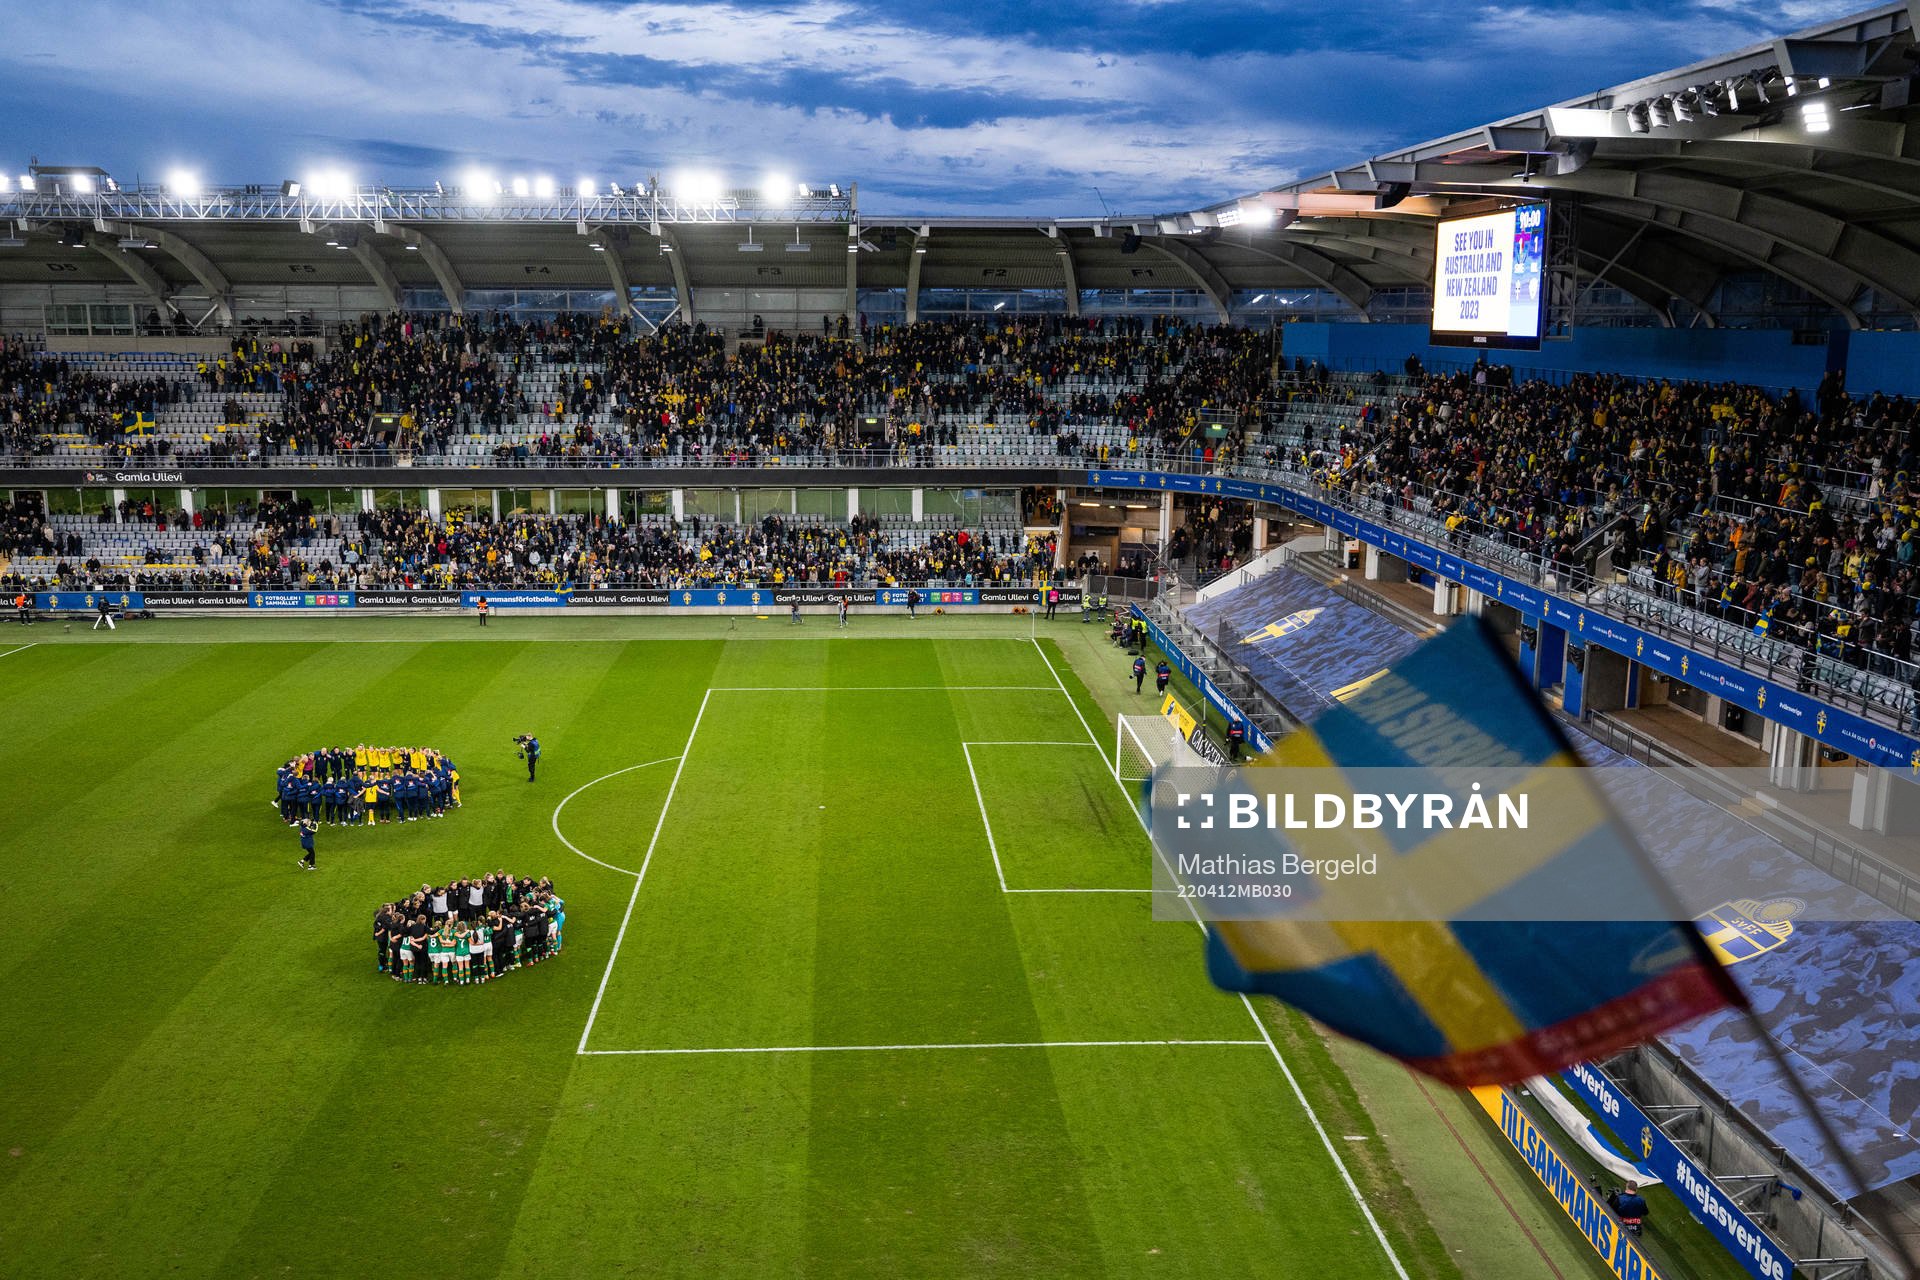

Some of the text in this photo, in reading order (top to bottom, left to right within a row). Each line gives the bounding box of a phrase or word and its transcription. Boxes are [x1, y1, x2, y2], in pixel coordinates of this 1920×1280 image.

[1455, 228, 1494, 252] SEE YOU IN
[46, 262, 77, 272] D5
[289, 264, 314, 273] F5
[1445, 254, 1483, 275] AUSTRALIA
[1485, 252, 1502, 272] AND
[984, 268, 1007, 277] F2
[1132, 268, 1153, 277] F1
[1446, 276, 1498, 297] NEW ZEALAND
[1460, 300, 1480, 320] 2023
[115, 472, 182, 482] Gamla Ullevi
[144, 596, 194, 606] Gamla Ullevi
[198, 596, 248, 606] Gamla Ullevi
[358, 596, 408, 605] Gamla Ullevi
[411, 595, 460, 604] Gamla Ullevi
[620, 595, 669, 603] Gamla Ullevi
[802, 594, 824, 602] Ullevi
[854, 594, 876, 602] Ullevi
[981, 593, 1006, 601] Gamla
[1007, 593, 1029, 601] Ullevi
[1058, 593, 1080, 601] Ullevi
[430, 937, 437, 948] 8
[459, 938, 465, 949] 7
[1568, 1062, 1620, 1118] sverige
[1501, 1093, 1613, 1260] TILLSAMMANS
[1676, 1159, 1784, 1280] #hejasverige
